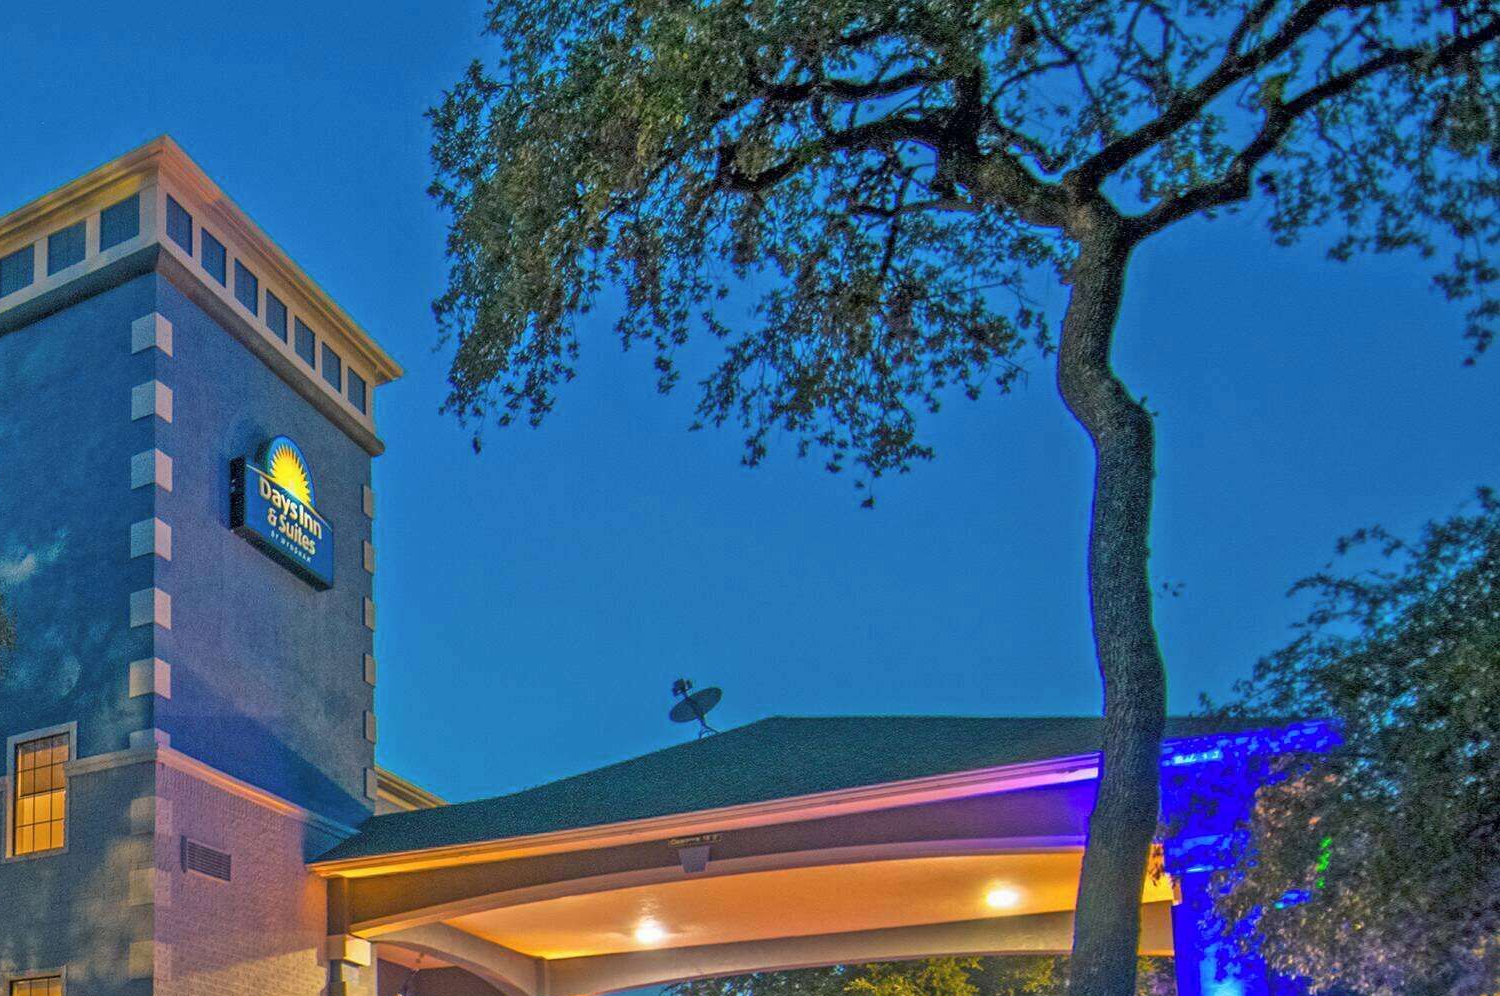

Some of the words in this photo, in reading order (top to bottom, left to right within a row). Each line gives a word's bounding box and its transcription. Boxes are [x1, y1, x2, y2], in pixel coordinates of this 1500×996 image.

[260, 477, 298, 519] Days
[299, 504, 322, 539] Inn
[267, 508, 277, 526] &
[278, 514, 316, 555] Suites
